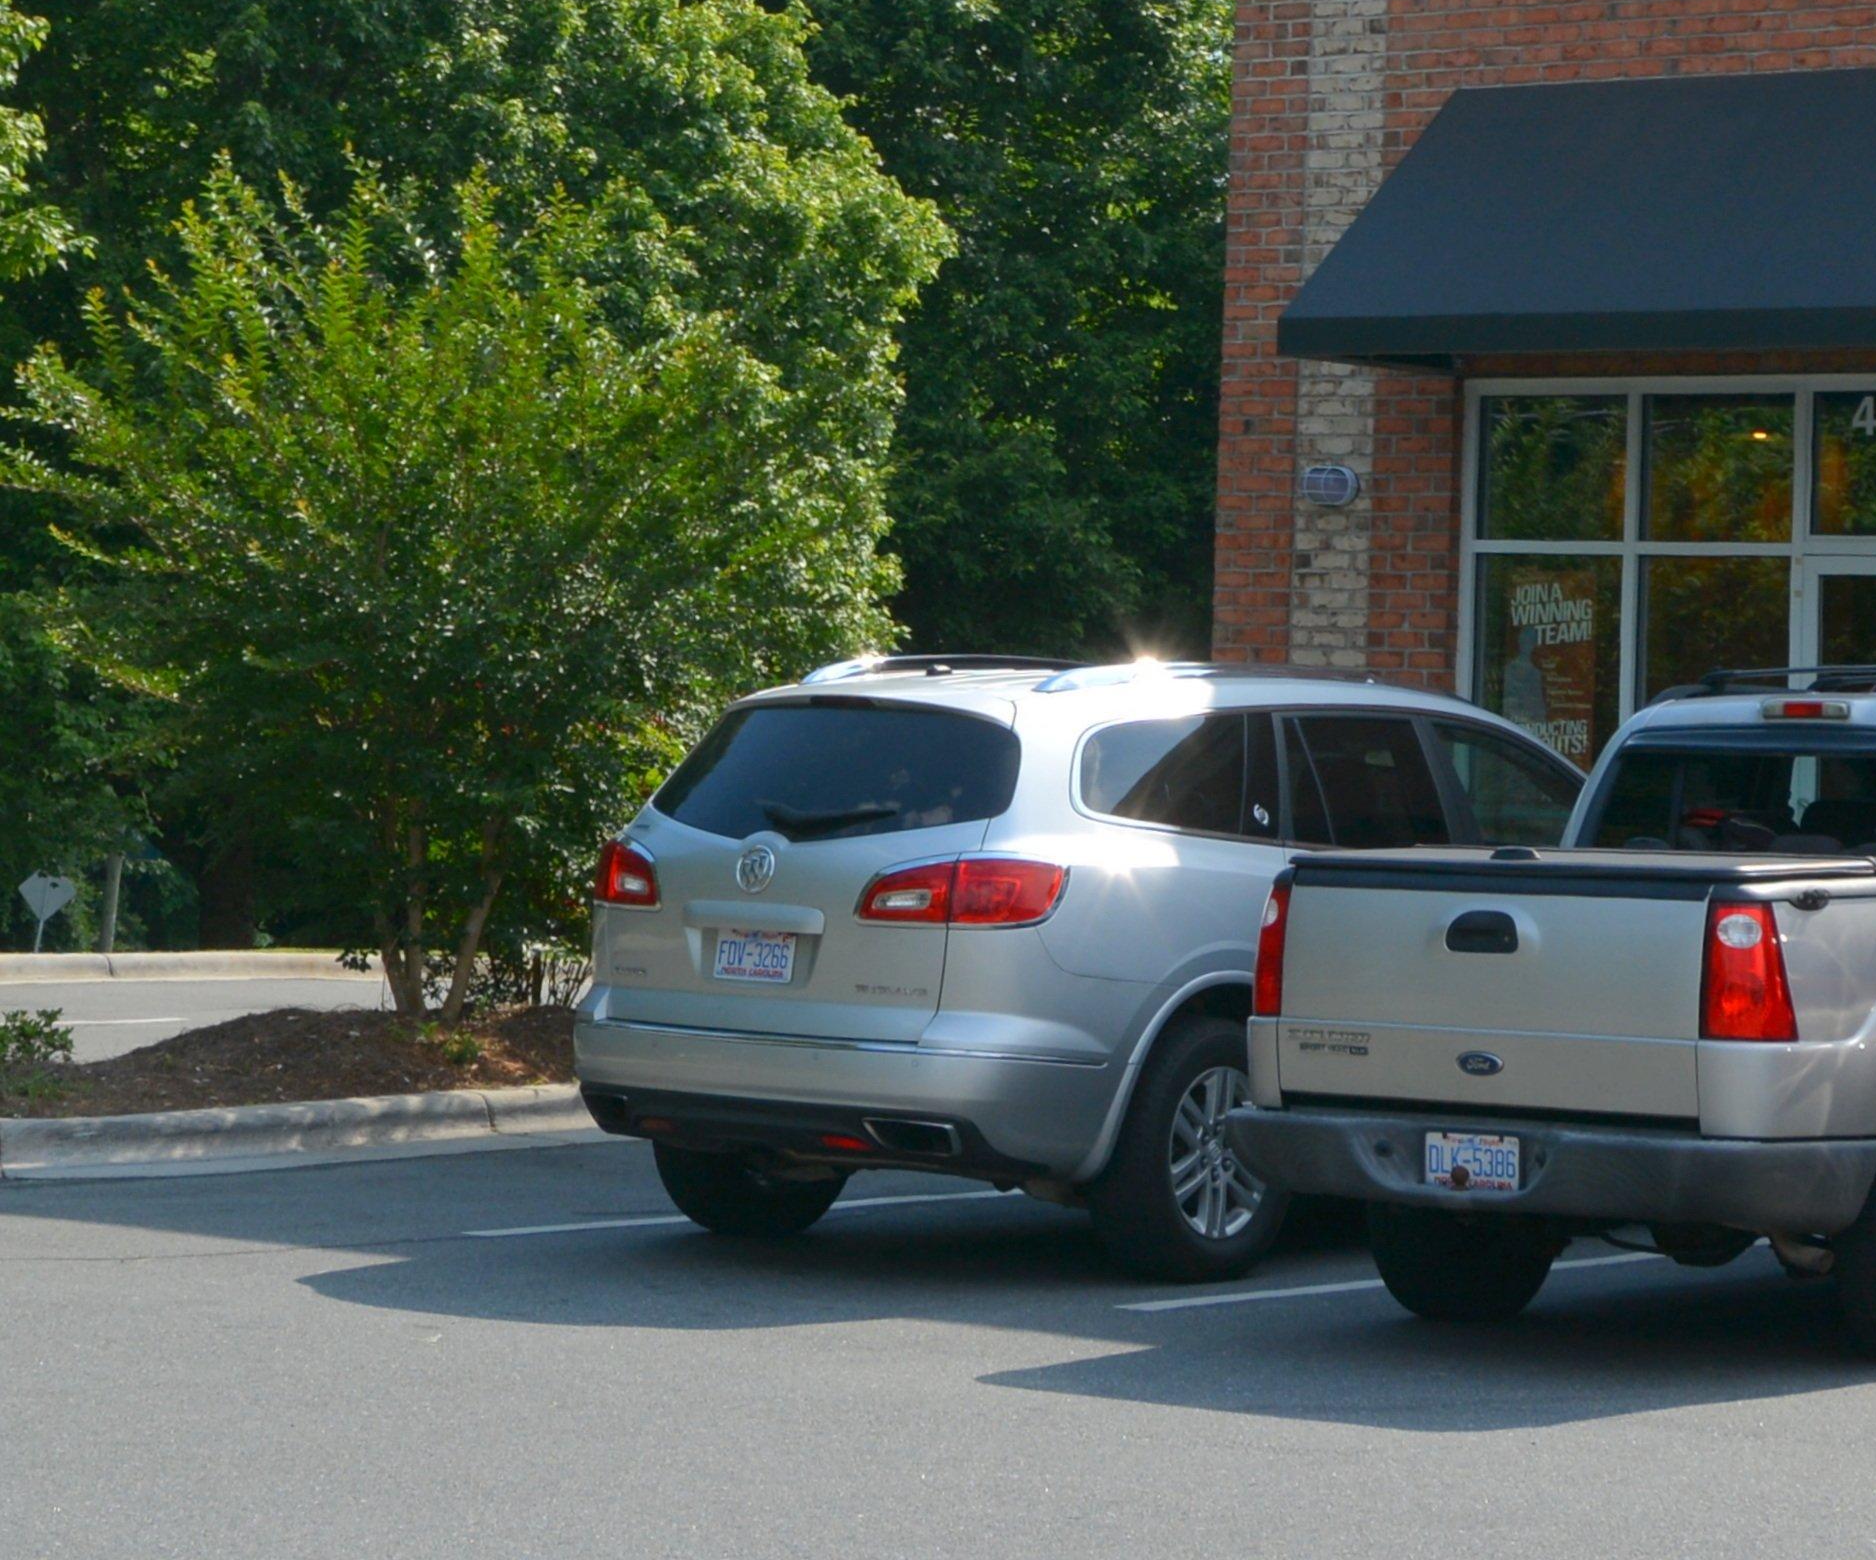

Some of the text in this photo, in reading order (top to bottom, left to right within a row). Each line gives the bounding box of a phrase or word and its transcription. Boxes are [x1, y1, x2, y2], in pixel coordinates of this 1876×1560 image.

[1510, 582, 1563, 606] JOIN A
[1510, 598, 1592, 628] WINNING
[1534, 620, 1592, 646] TEAM!
[1428, 1144, 1517, 1179] DLK-5386
